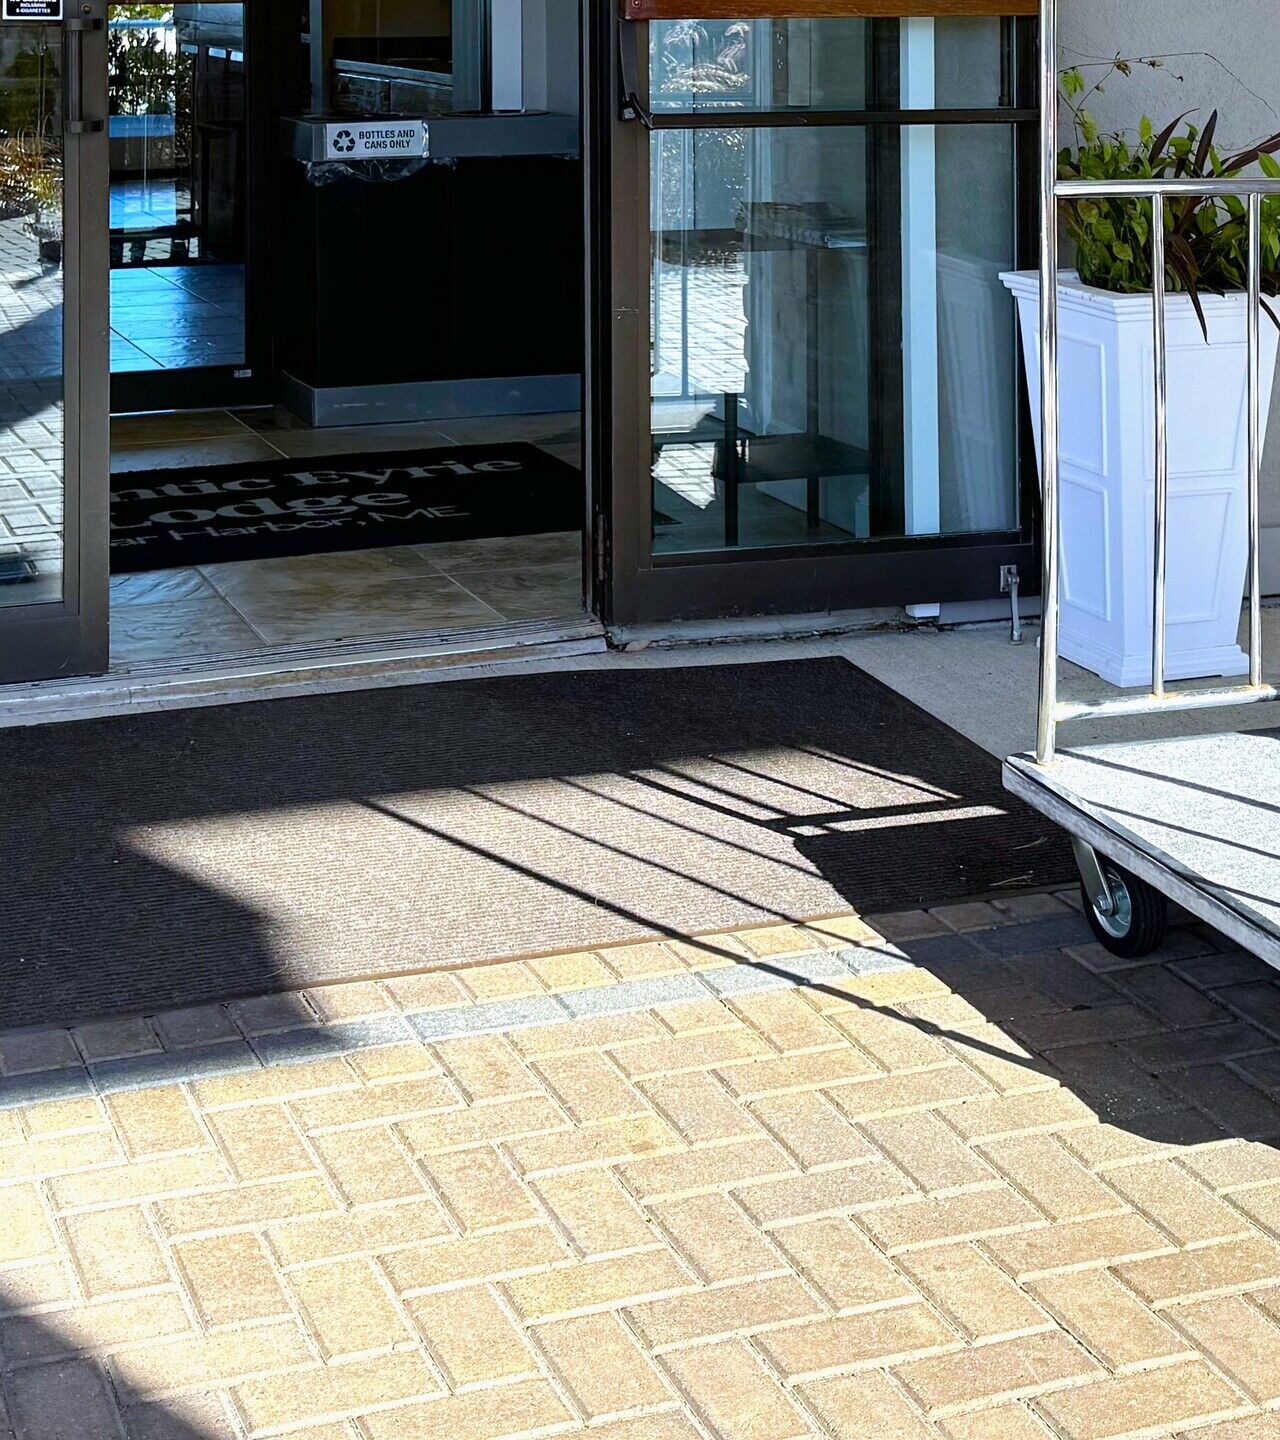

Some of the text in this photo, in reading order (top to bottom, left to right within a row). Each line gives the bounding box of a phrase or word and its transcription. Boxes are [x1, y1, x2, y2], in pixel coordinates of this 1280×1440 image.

[359, 129, 415, 139] BOTTLES AND
[364, 139, 411, 149] CANS ONLY
[110, 460, 526, 502] ntic Eyrie
[110, 505, 472, 547] ar Harbor, ME
